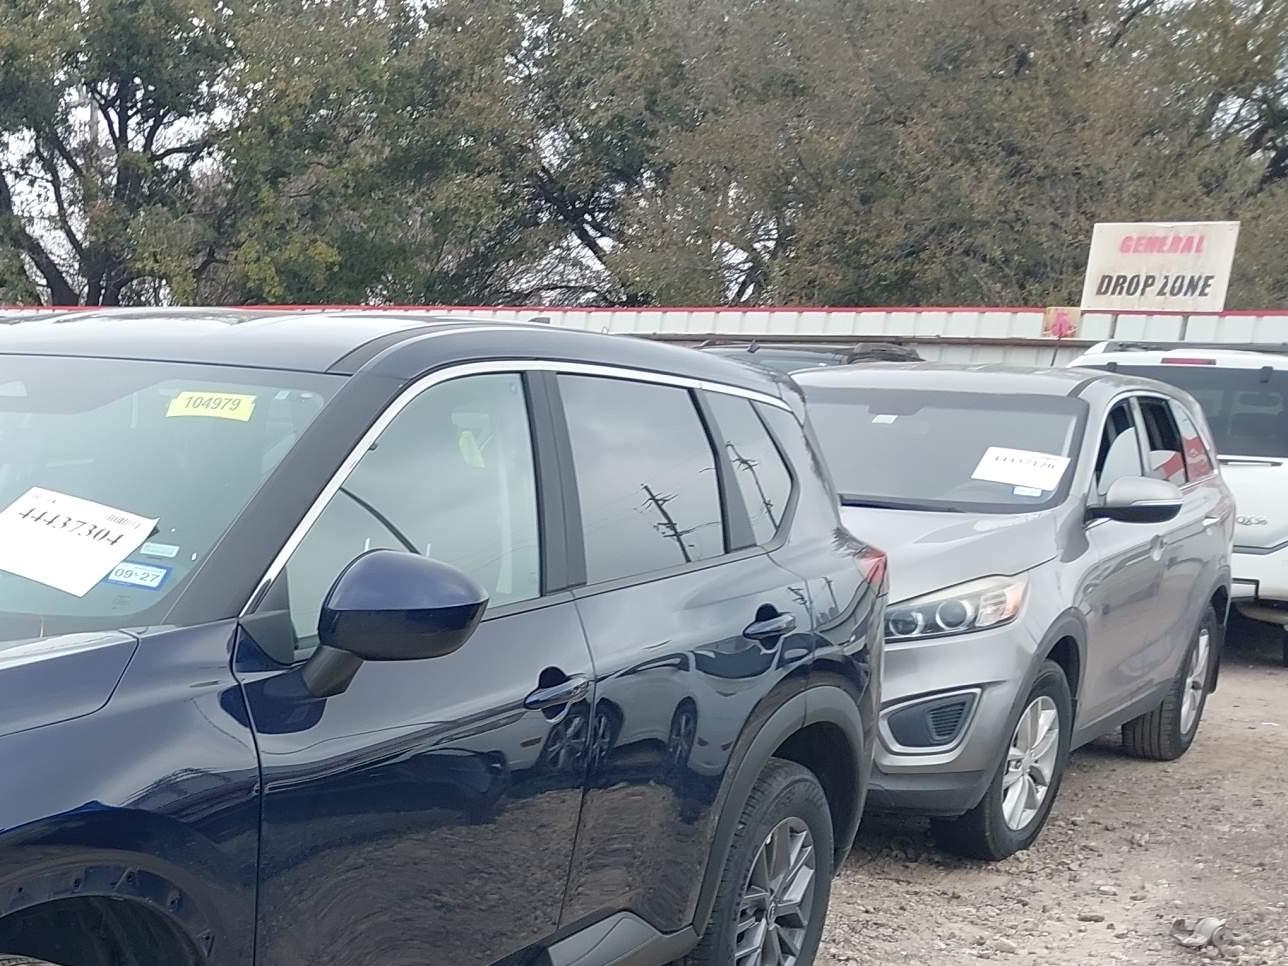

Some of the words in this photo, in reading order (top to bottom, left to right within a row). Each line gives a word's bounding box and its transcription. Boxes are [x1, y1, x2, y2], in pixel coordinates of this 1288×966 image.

[1120, 235, 1205, 254] GENERAL
[1096, 274, 1156, 296] DROP
[1157, 274, 1214, 296] ZONE
[184, 396, 241, 412] 104979
[18, 507, 124, 545] 44437304
